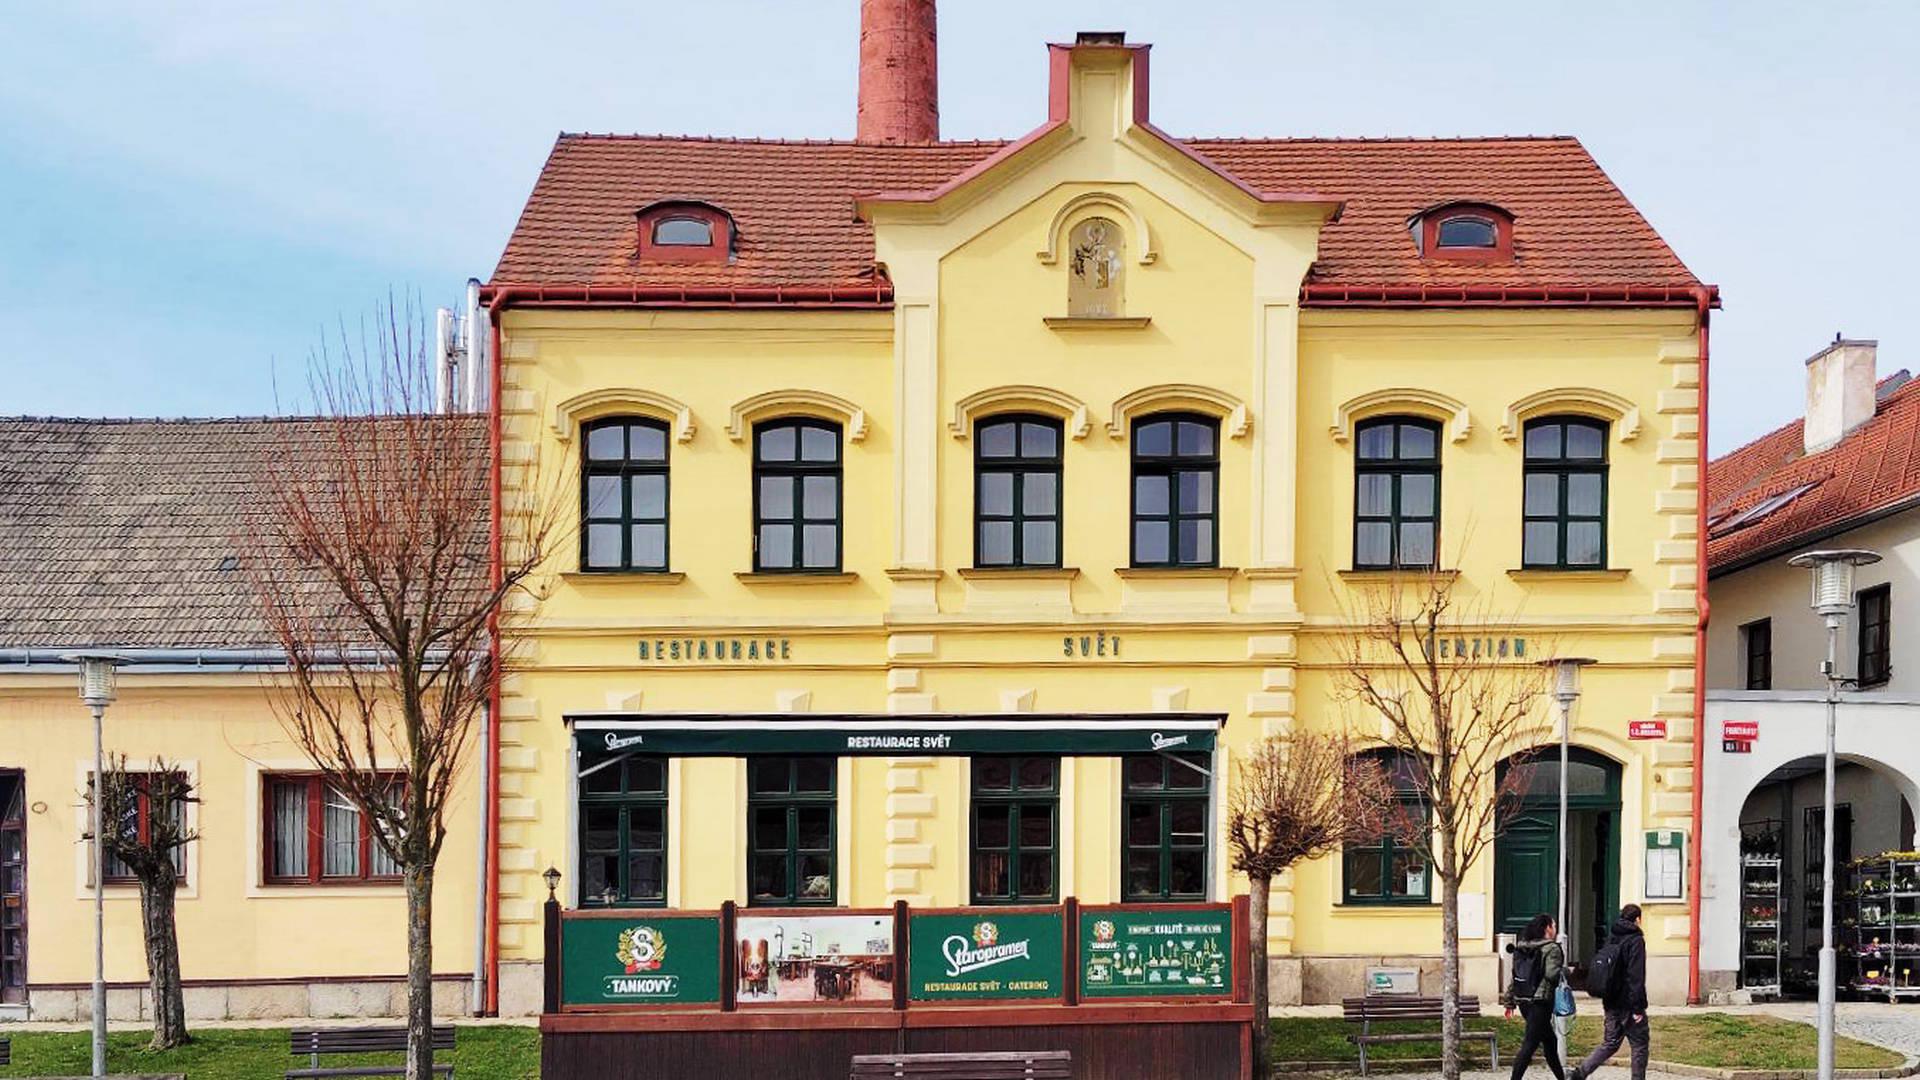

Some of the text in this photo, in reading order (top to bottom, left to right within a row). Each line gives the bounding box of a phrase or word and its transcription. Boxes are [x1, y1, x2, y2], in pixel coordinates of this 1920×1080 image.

[638, 639, 791, 660] RESTAURACE
[847, 736, 920, 748] RESTAURACE
[942, 935, 1031, 977] Staropramen
[611, 976, 672, 993] TANKOVÝ
[924, 981, 978, 992] RESTAURACE
[1008, 981, 1049, 990] CATERING
